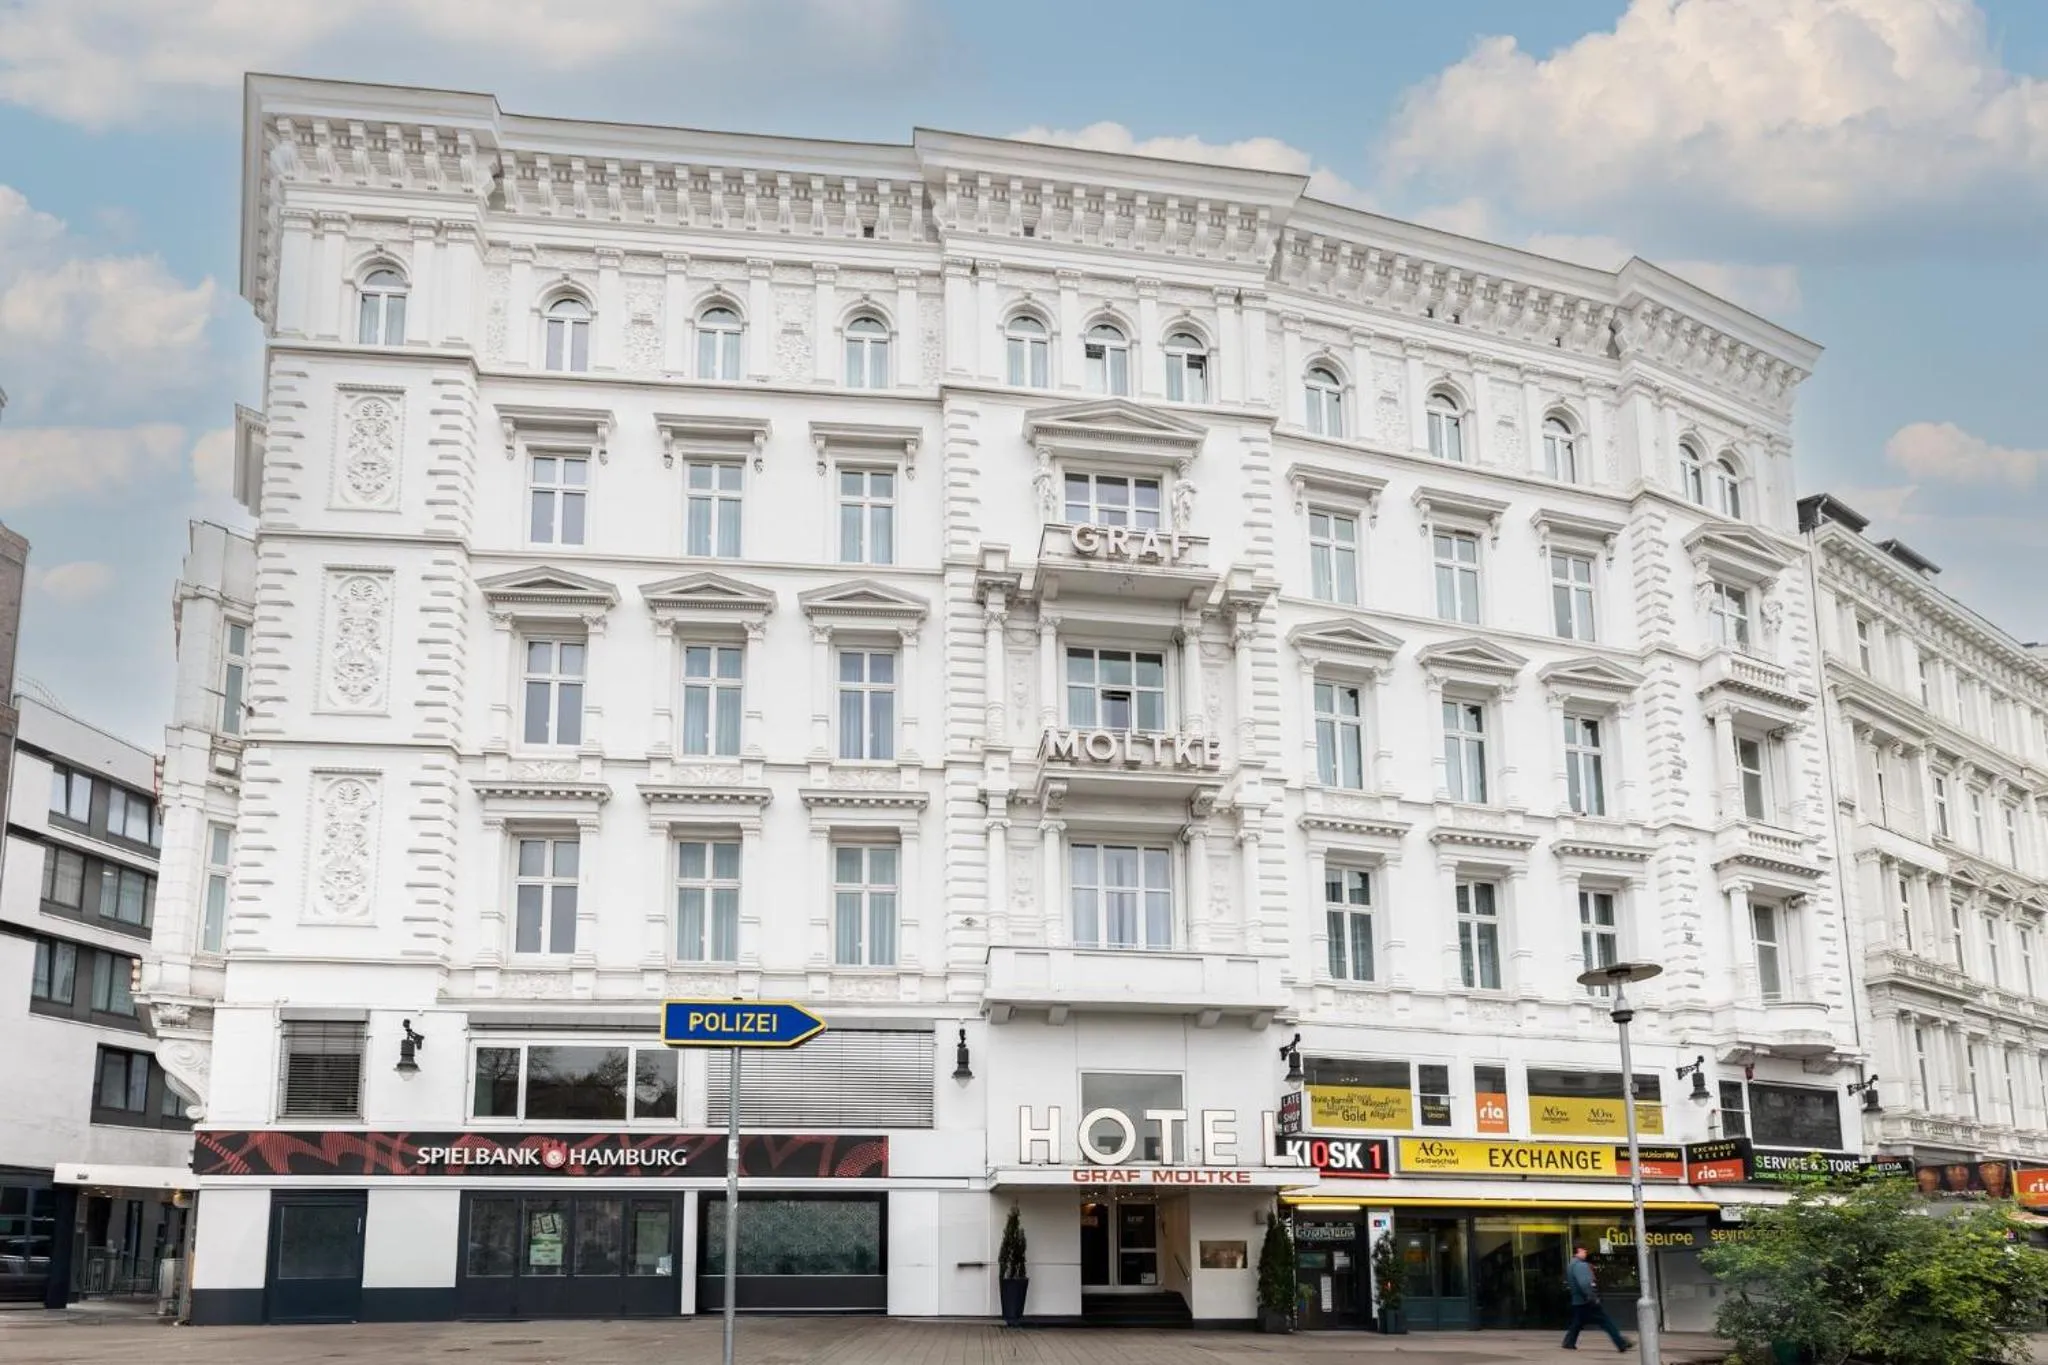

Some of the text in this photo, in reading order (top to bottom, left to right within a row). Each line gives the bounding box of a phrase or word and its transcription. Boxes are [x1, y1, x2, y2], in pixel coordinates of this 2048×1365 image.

[1071, 523, 1191, 558] GRAF
[1049, 729, 1221, 766] MOLTKE
[688, 1012, 778, 1033] POLIZEI
[1341, 1109, 1366, 1121] Gold
[1480, 1101, 1504, 1119] ria
[1019, 1105, 1298, 1167] HOTEL
[417, 1147, 687, 1166] SPIELBANK HAMBURG
[1285, 1140, 1381, 1169] KIOSK 1
[1488, 1147, 1602, 1170] EXCHANGE
[1755, 1155, 1808, 1171] SERVICE
[1821, 1159, 1860, 1174] STORE
[1072, 1169, 1251, 1184] GRAF MOLTKE
[1697, 1165, 1717, 1180] ria
